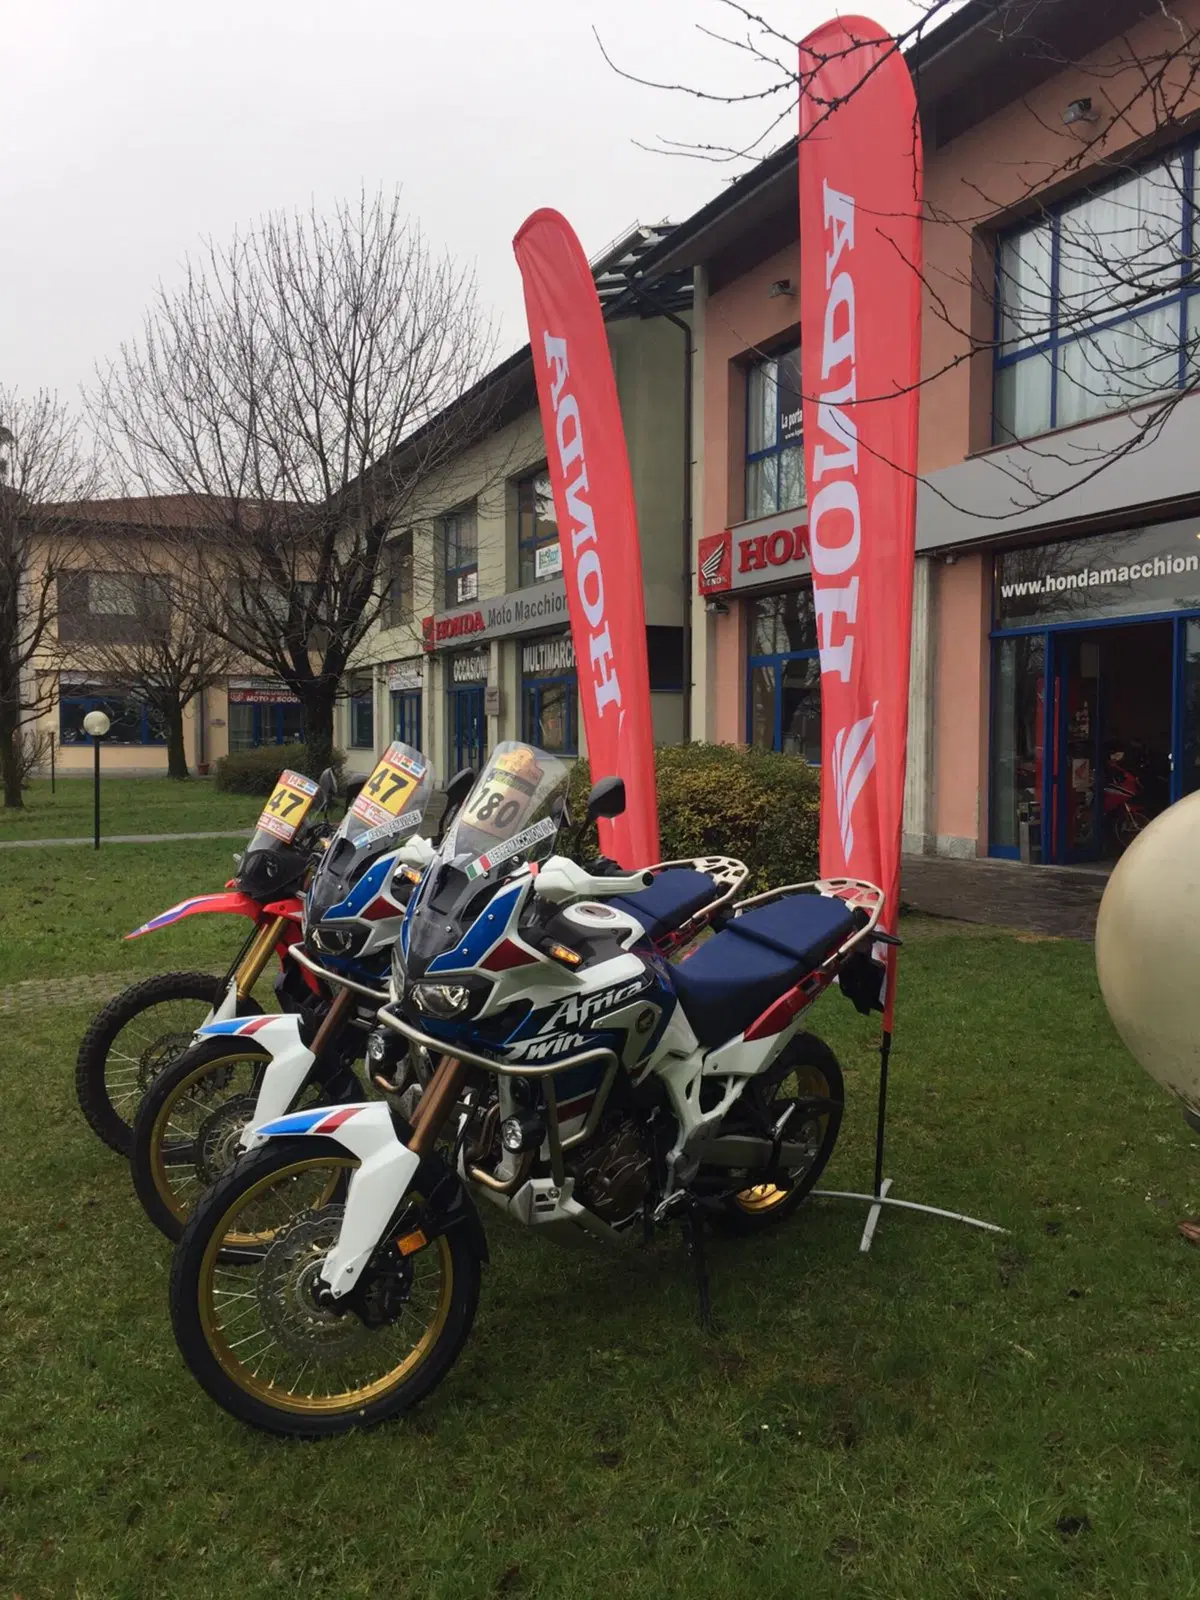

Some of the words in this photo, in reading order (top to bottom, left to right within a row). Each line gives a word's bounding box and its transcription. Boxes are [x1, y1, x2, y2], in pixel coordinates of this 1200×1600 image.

[781, 413, 788, 429] La
[1001, 554, 1198, 598] www.hondamacchion
[436, 610, 486, 640] HONDA
[487, 604, 512, 628] Moto
[367, 767, 408, 803] 47
[269, 789, 304, 818] 47
[468, 787, 520, 829] 180
[507, 825, 544, 854] MACCHION
[537, 981, 645, 1035] Africa
[503, 1031, 598, 1061] Twin
